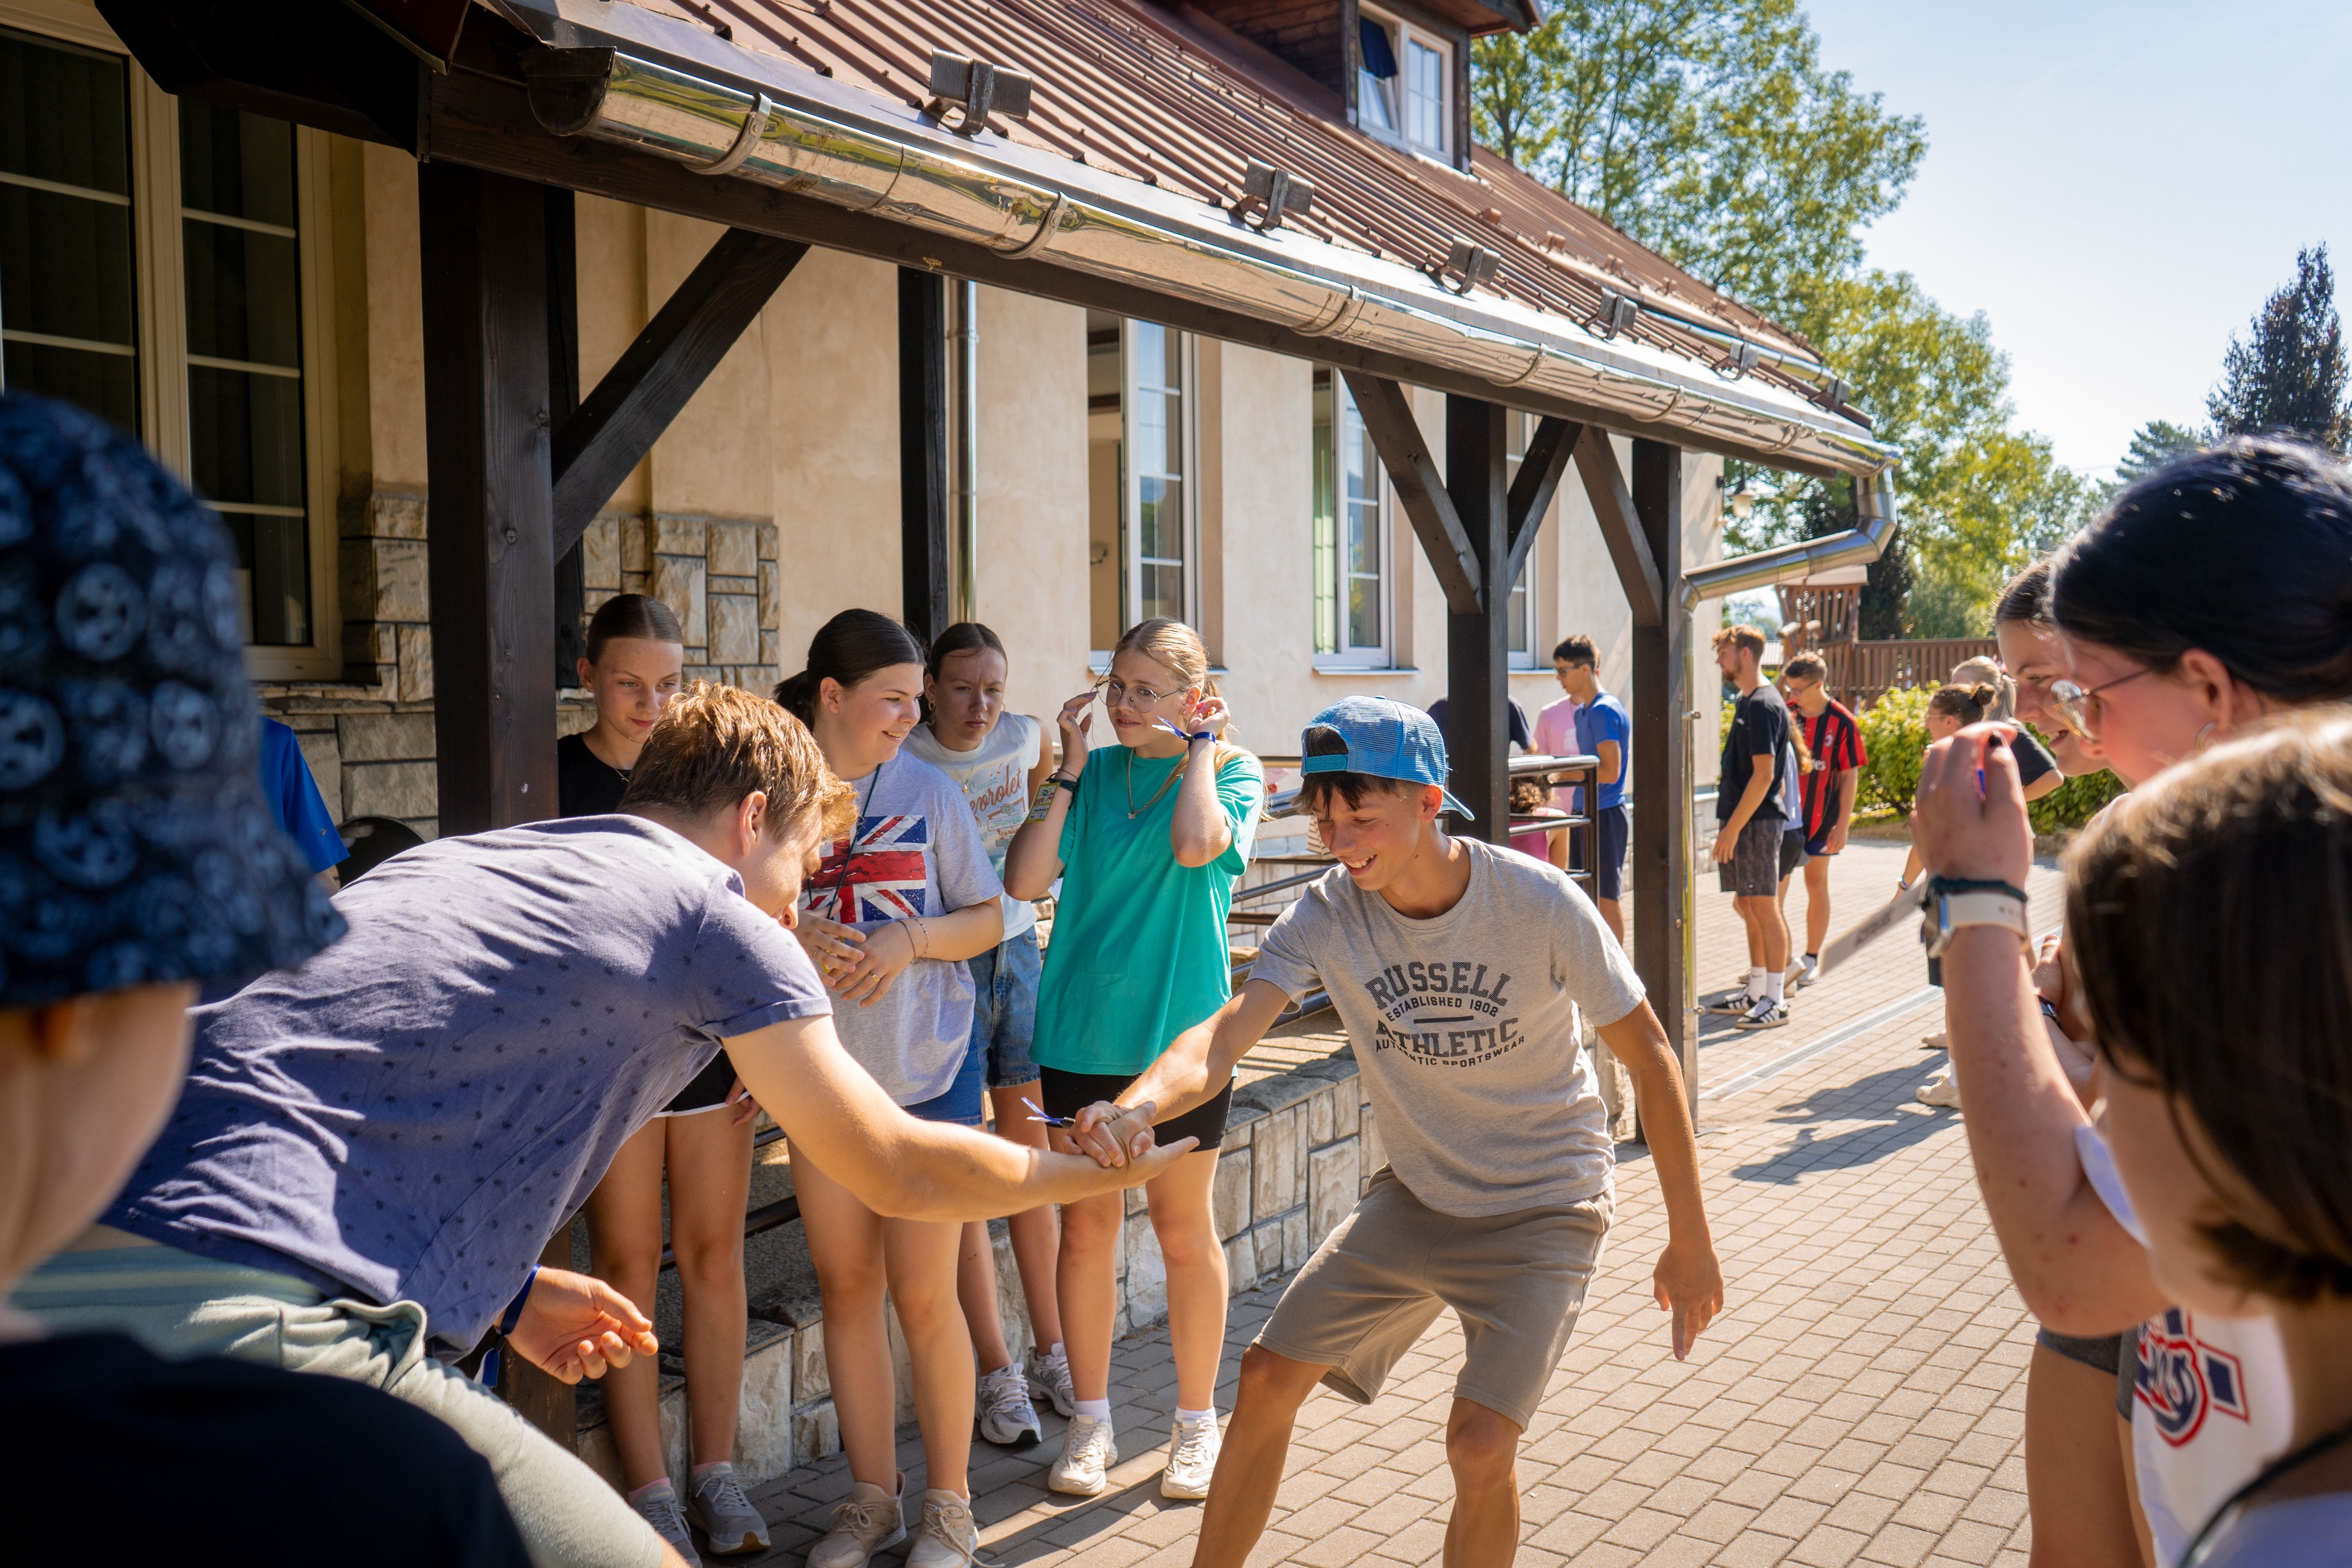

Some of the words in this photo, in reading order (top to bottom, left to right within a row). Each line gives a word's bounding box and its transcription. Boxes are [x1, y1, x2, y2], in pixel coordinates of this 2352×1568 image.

[969, 777, 998, 794] Camaro
[970, 765, 1022, 815] evrolet
[1365, 961, 1511, 1010] RUSSELL
[1385, 996, 1462, 1022] ESTABLISHED
[1470, 999, 1499, 1017] 1902
[1376, 1017, 1519, 1058] ATHLETIC
[1442, 1036, 1524, 1067] SPORTSWEAR
